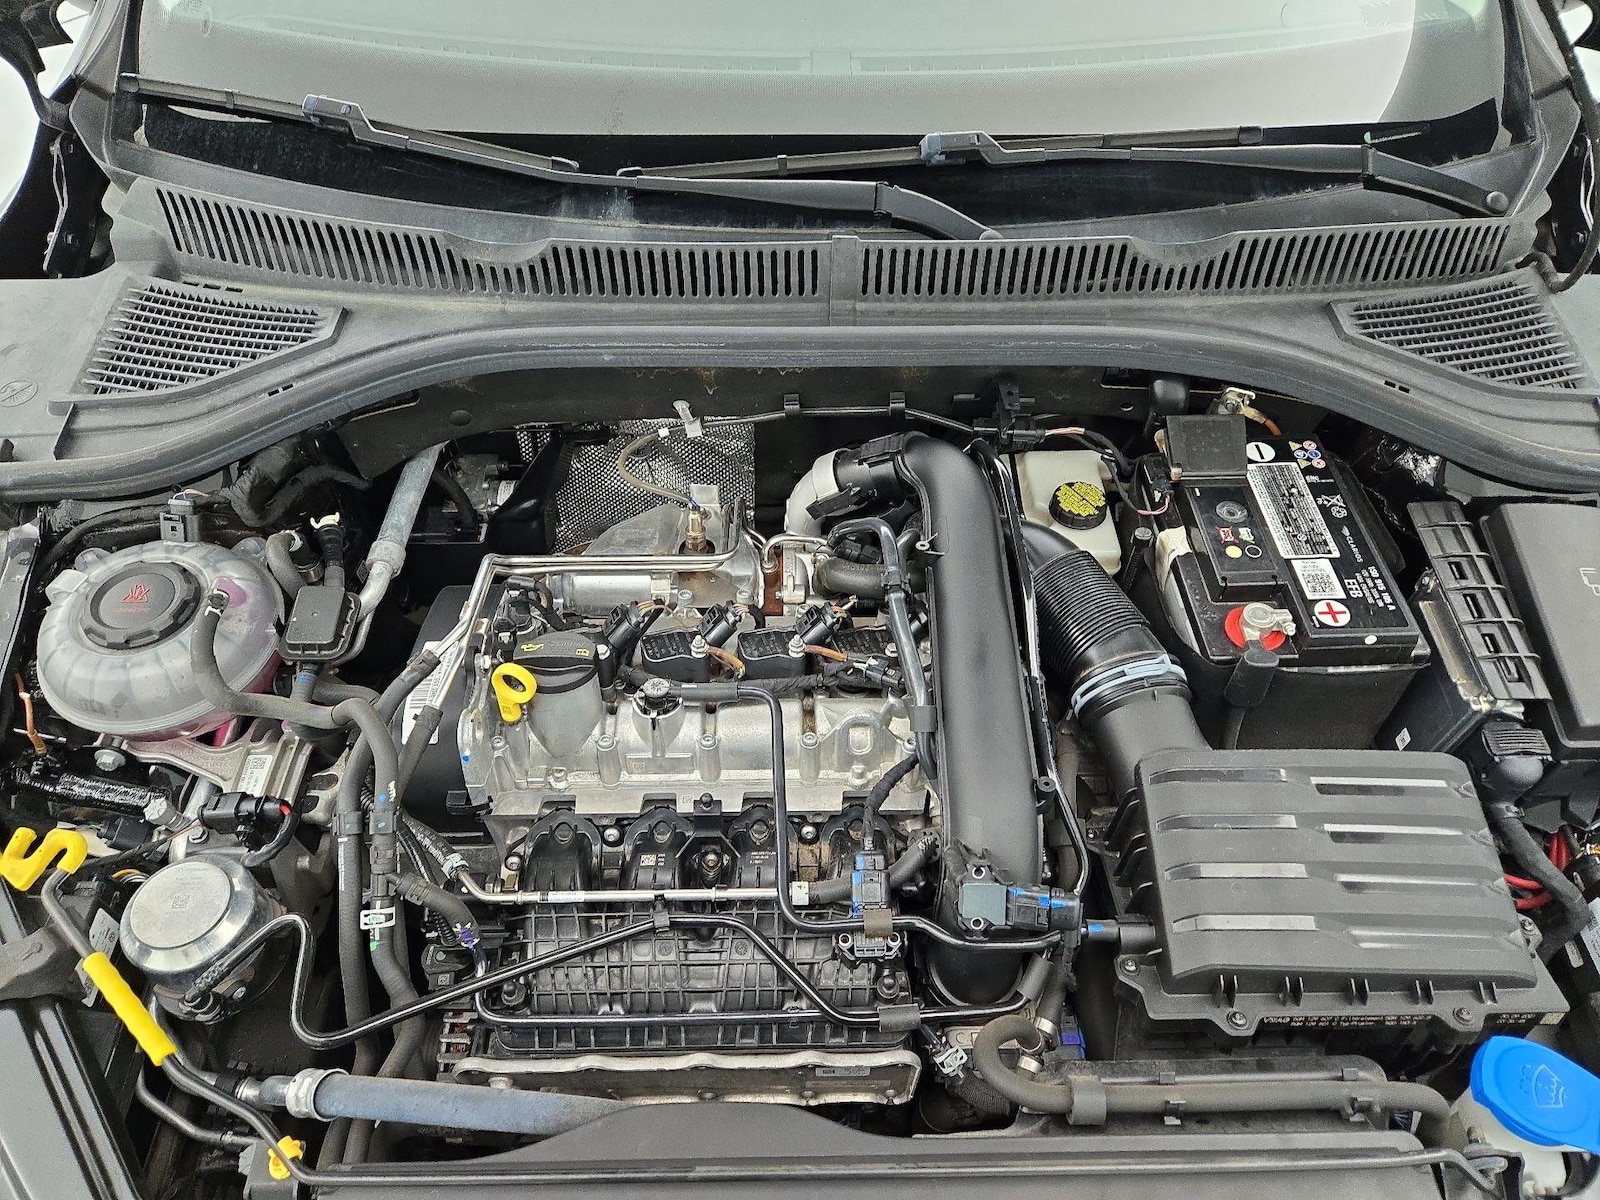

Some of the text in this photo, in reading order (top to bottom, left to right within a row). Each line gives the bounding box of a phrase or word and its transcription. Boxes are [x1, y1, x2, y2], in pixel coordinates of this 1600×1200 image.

[1346, 536, 1363, 563] CLARIOS
[1344, 579, 1364, 598] EFB
[1374, 578, 1387, 591] 915
[1381, 592, 1393, 604] 105
